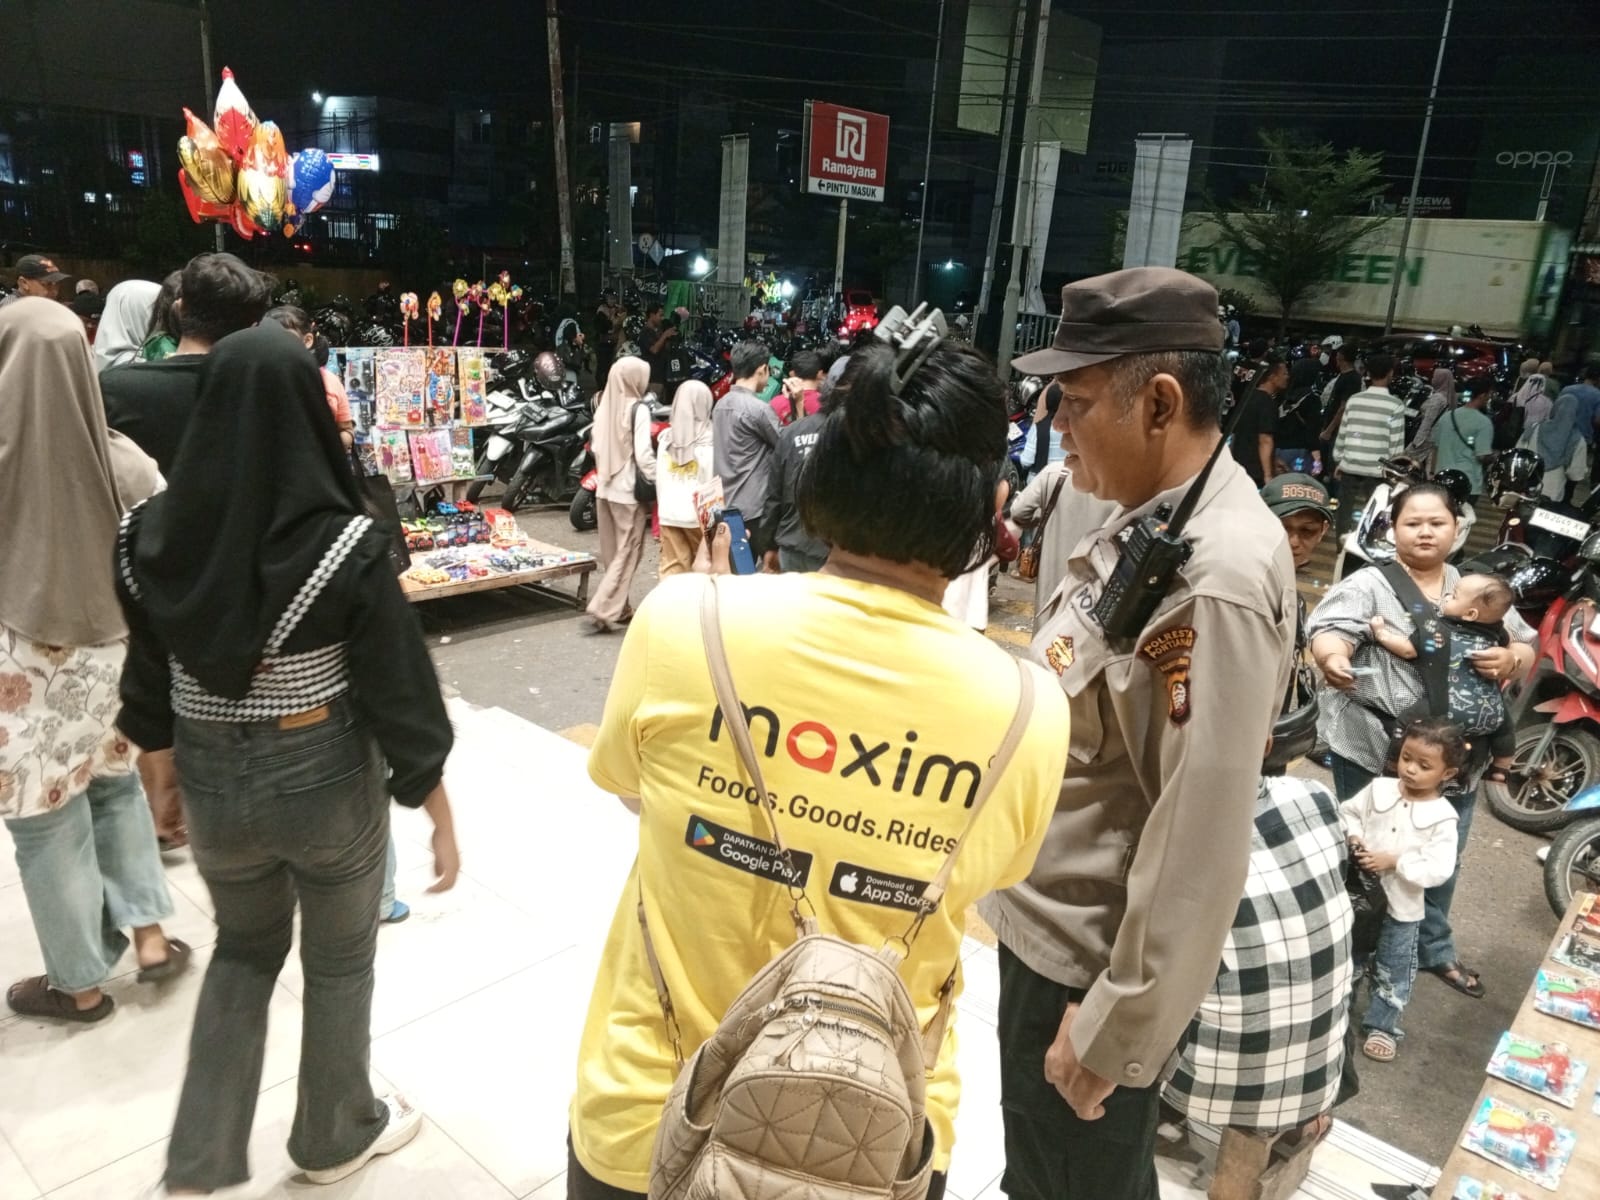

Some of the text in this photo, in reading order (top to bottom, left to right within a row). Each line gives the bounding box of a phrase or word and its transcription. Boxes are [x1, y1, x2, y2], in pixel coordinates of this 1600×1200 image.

[822, 157, 877, 179] Ramayana
[826, 182, 877, 198] PINTU MASUK
[1401, 196, 1451, 206] DSEWA
[1281, 484, 1325, 505] BOSTON
[709, 700, 982, 809] maxim
[723, 832, 768, 856] DAPATKAN
[719, 843, 770, 870] Google
[861, 884, 892, 903] App
[866, 875, 915, 892] Download di
